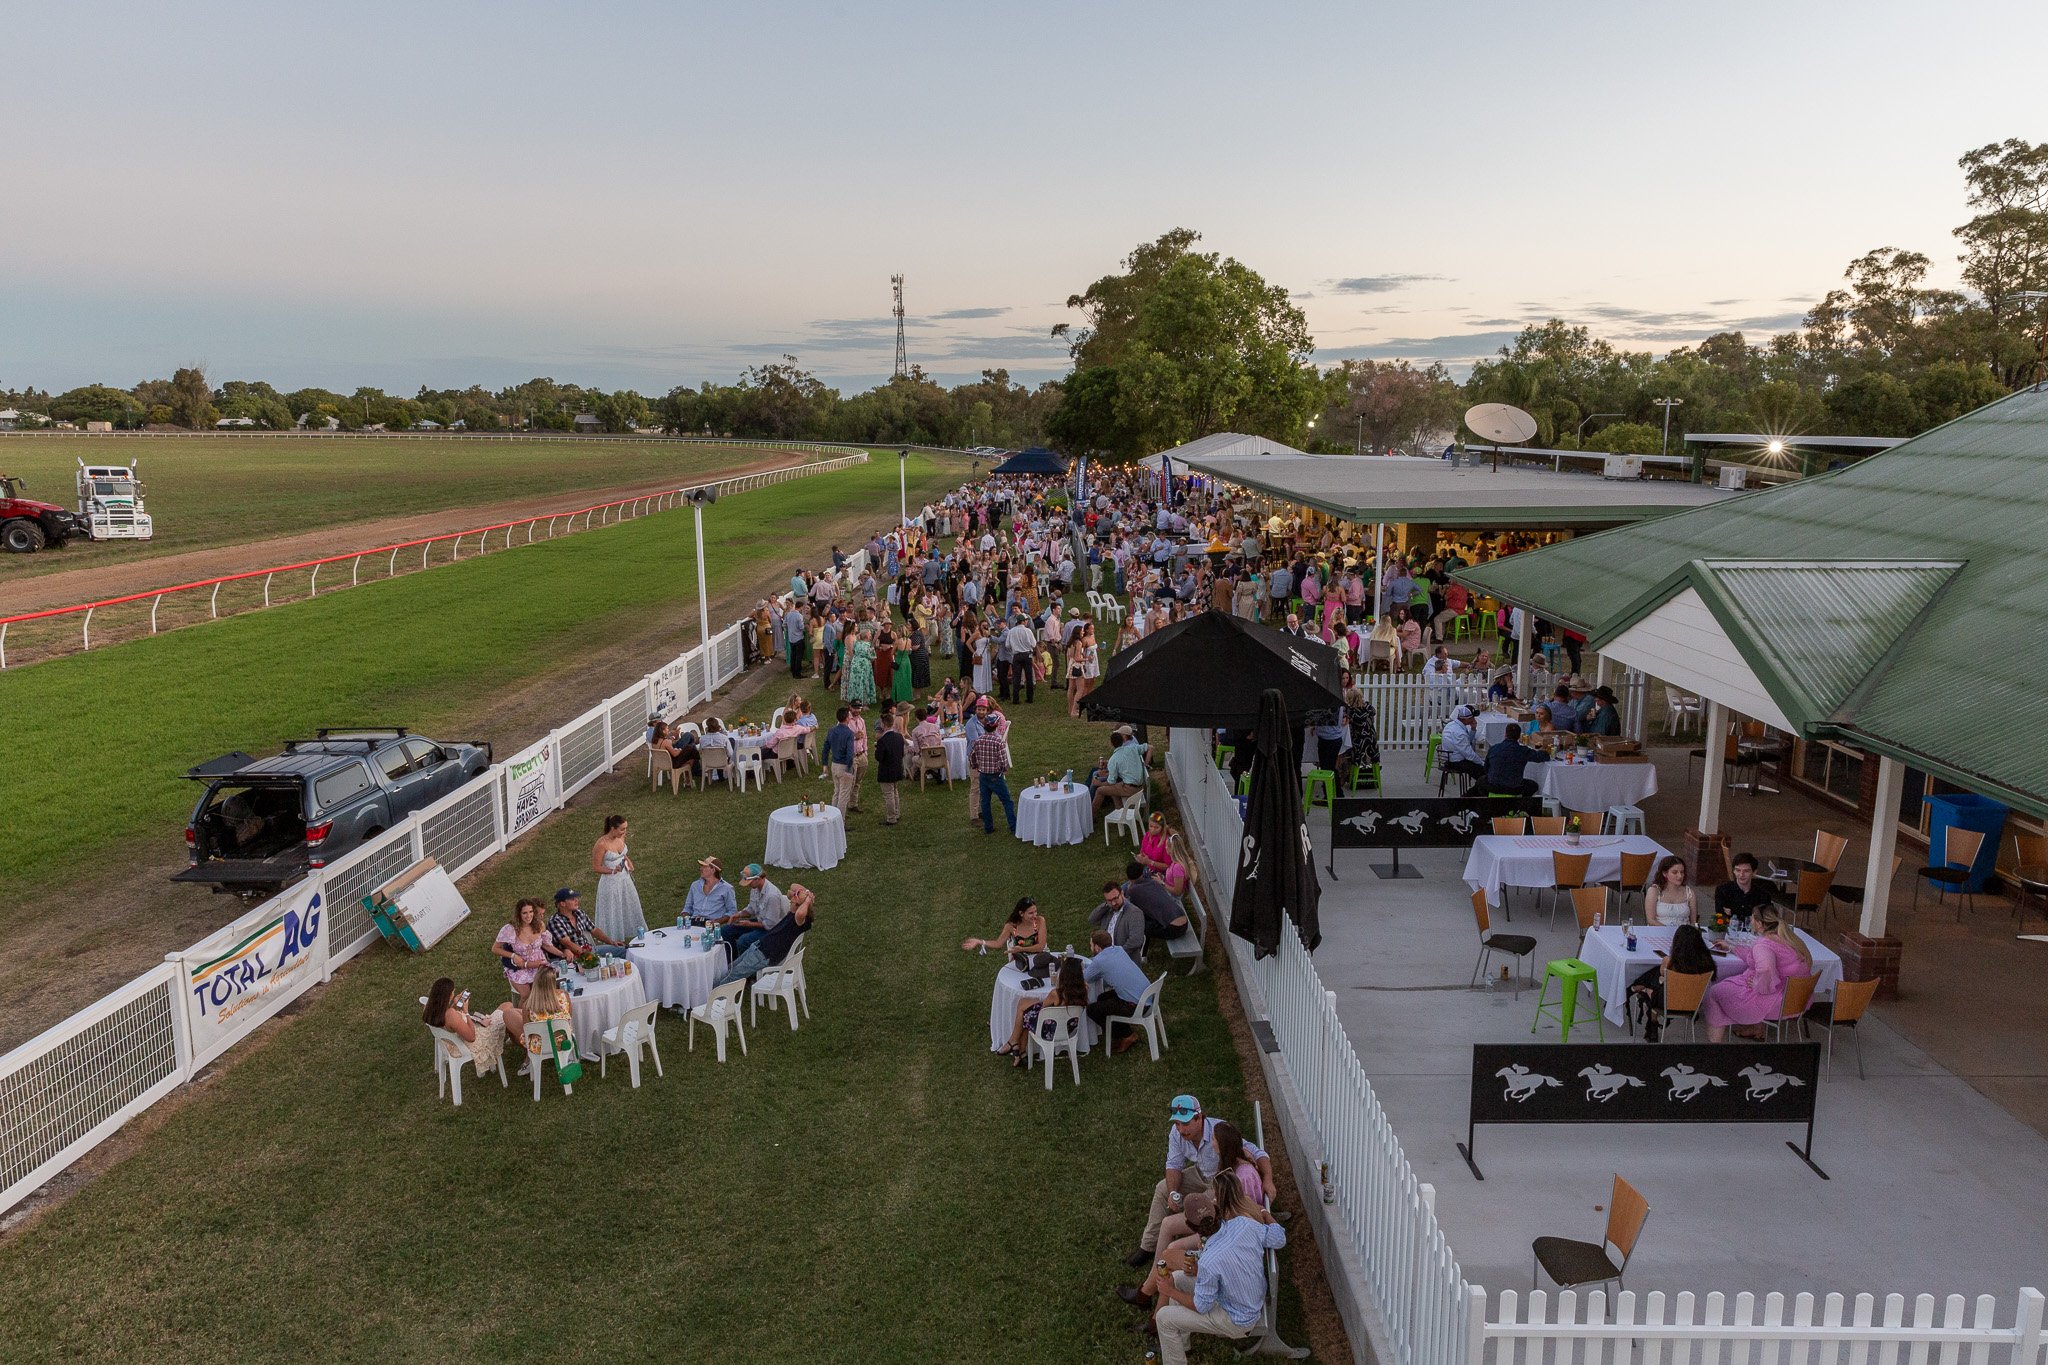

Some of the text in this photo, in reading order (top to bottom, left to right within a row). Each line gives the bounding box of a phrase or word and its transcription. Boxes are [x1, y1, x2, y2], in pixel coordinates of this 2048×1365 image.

[514, 806, 540, 831] SPRAYING
[516, 793, 539, 815] HAYES
[193, 891, 322, 1017] TOTAL AG
[217, 992, 260, 1025] Solutions
